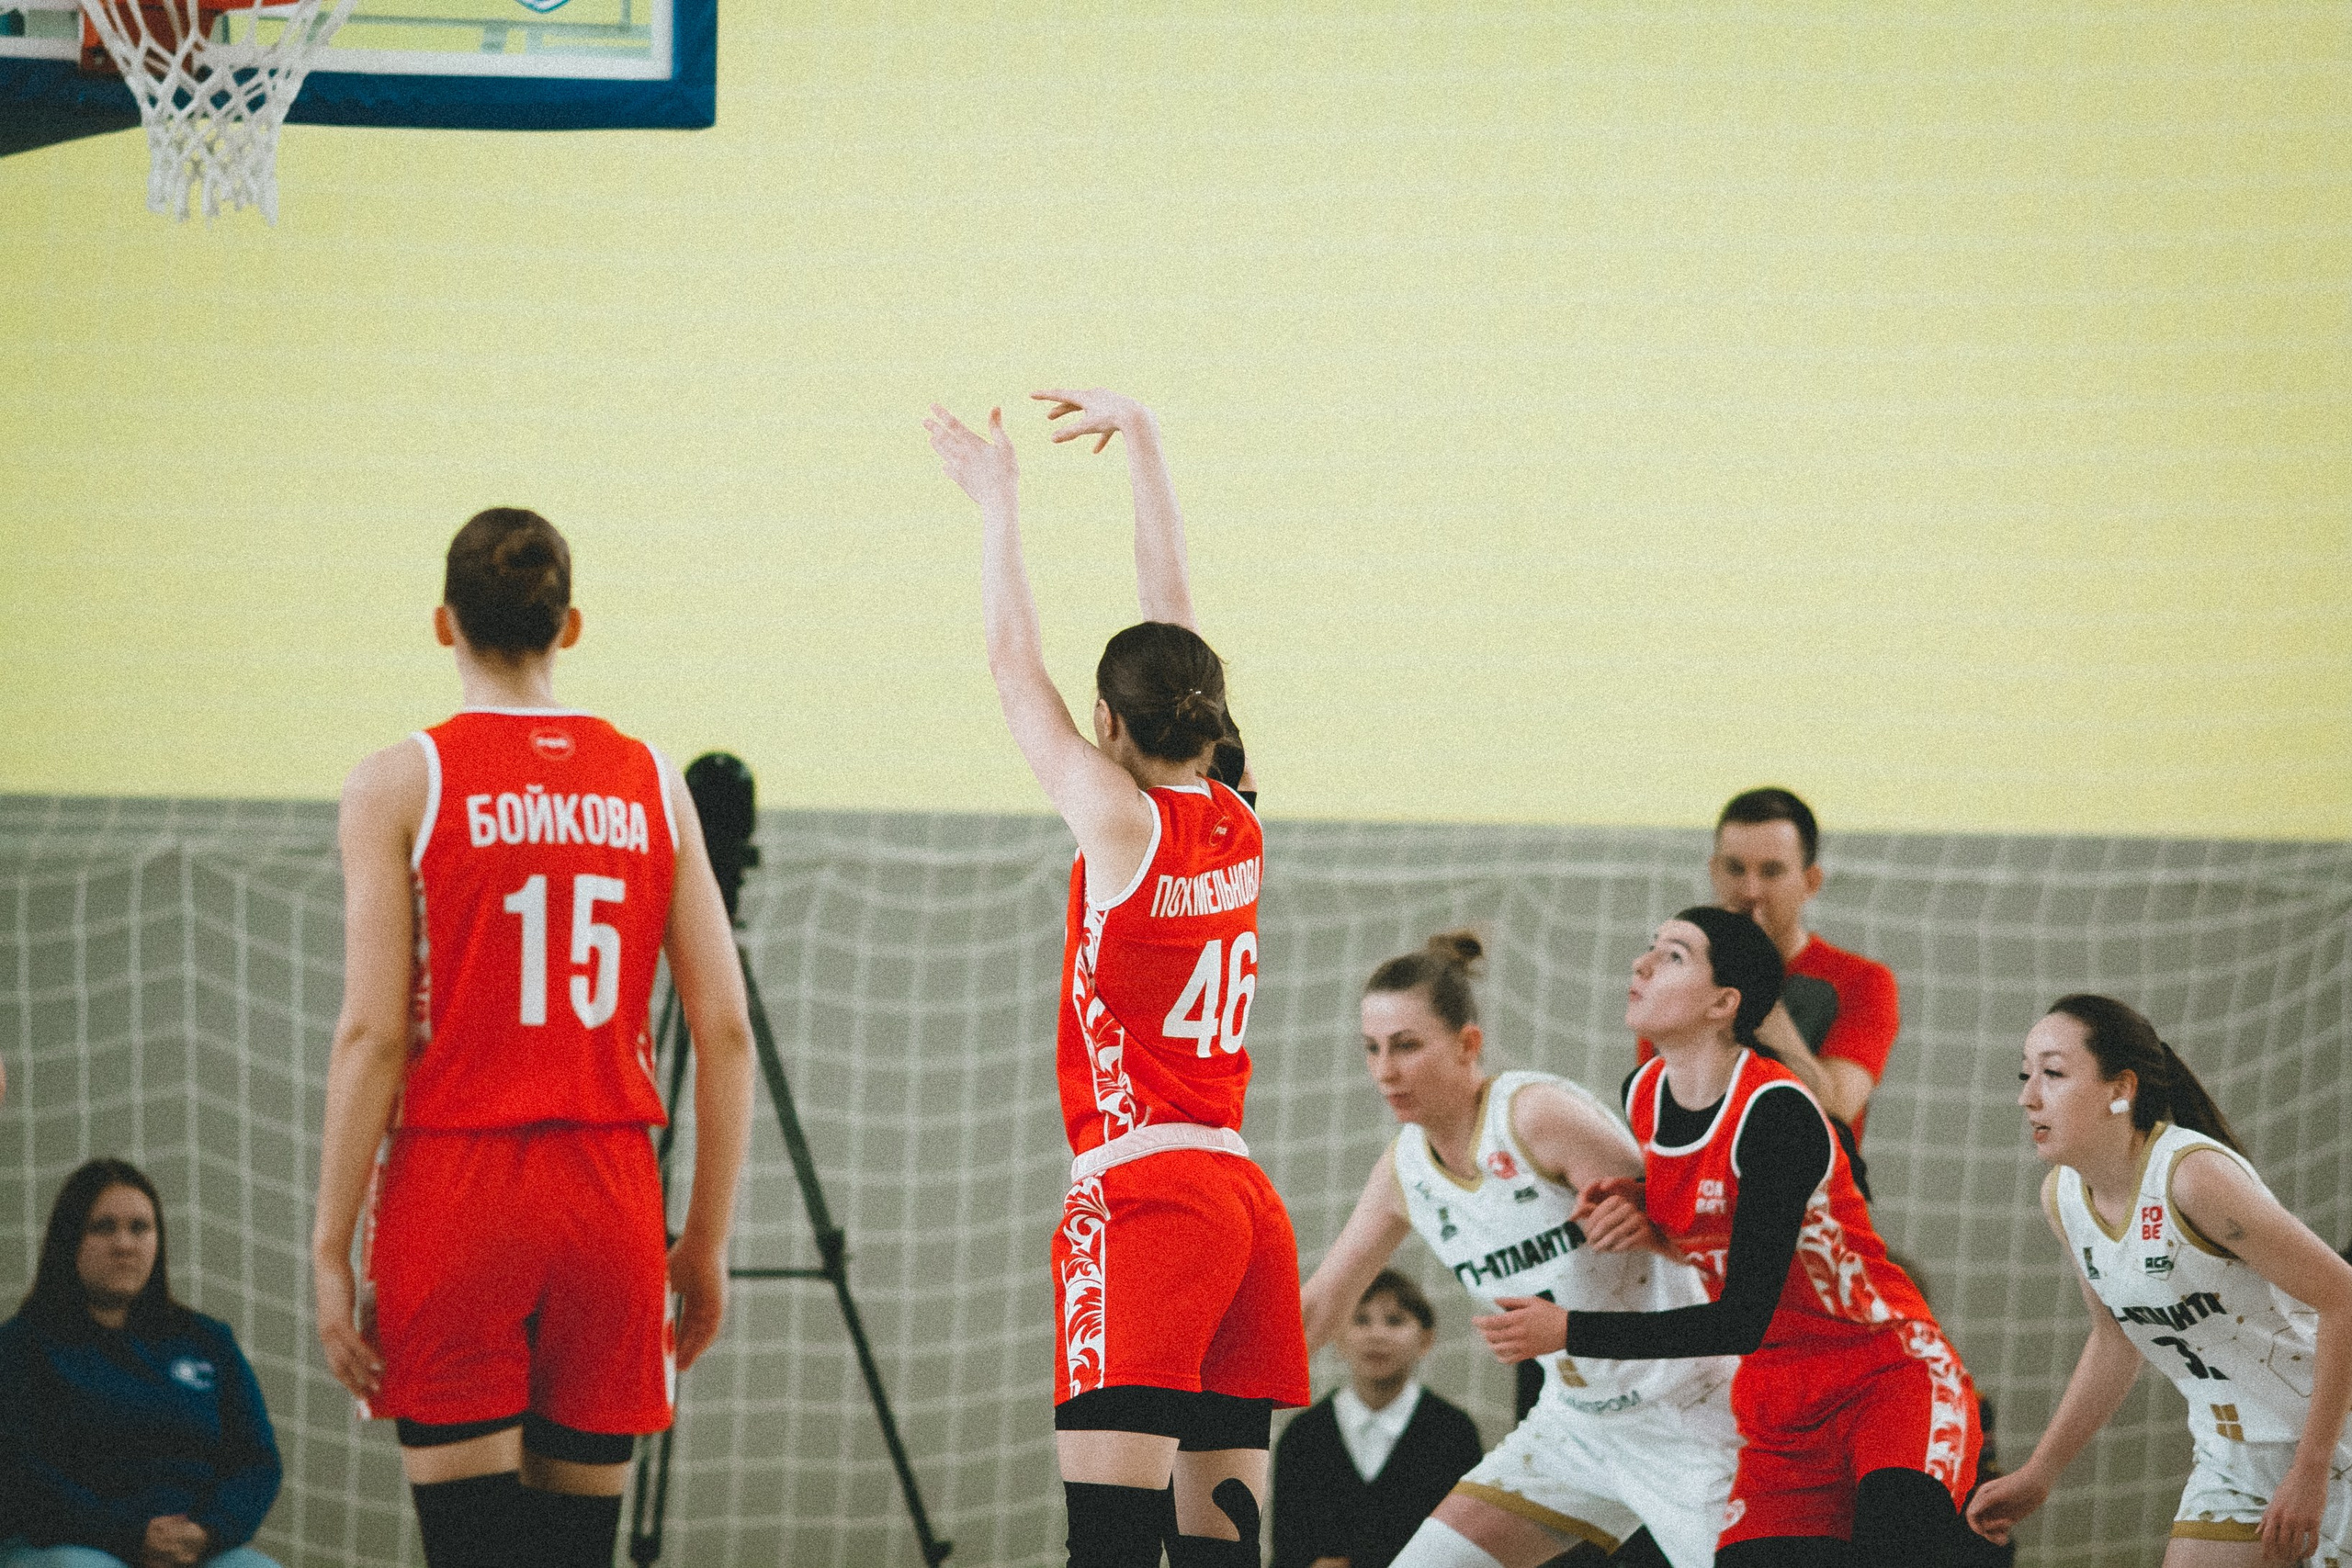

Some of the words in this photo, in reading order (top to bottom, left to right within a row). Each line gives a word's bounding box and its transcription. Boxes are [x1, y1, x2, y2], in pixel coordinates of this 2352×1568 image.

[466, 784, 650, 855] БОЙКОВА
[503, 873, 627, 1031] 15
[1161, 931, 1258, 1059] 46
